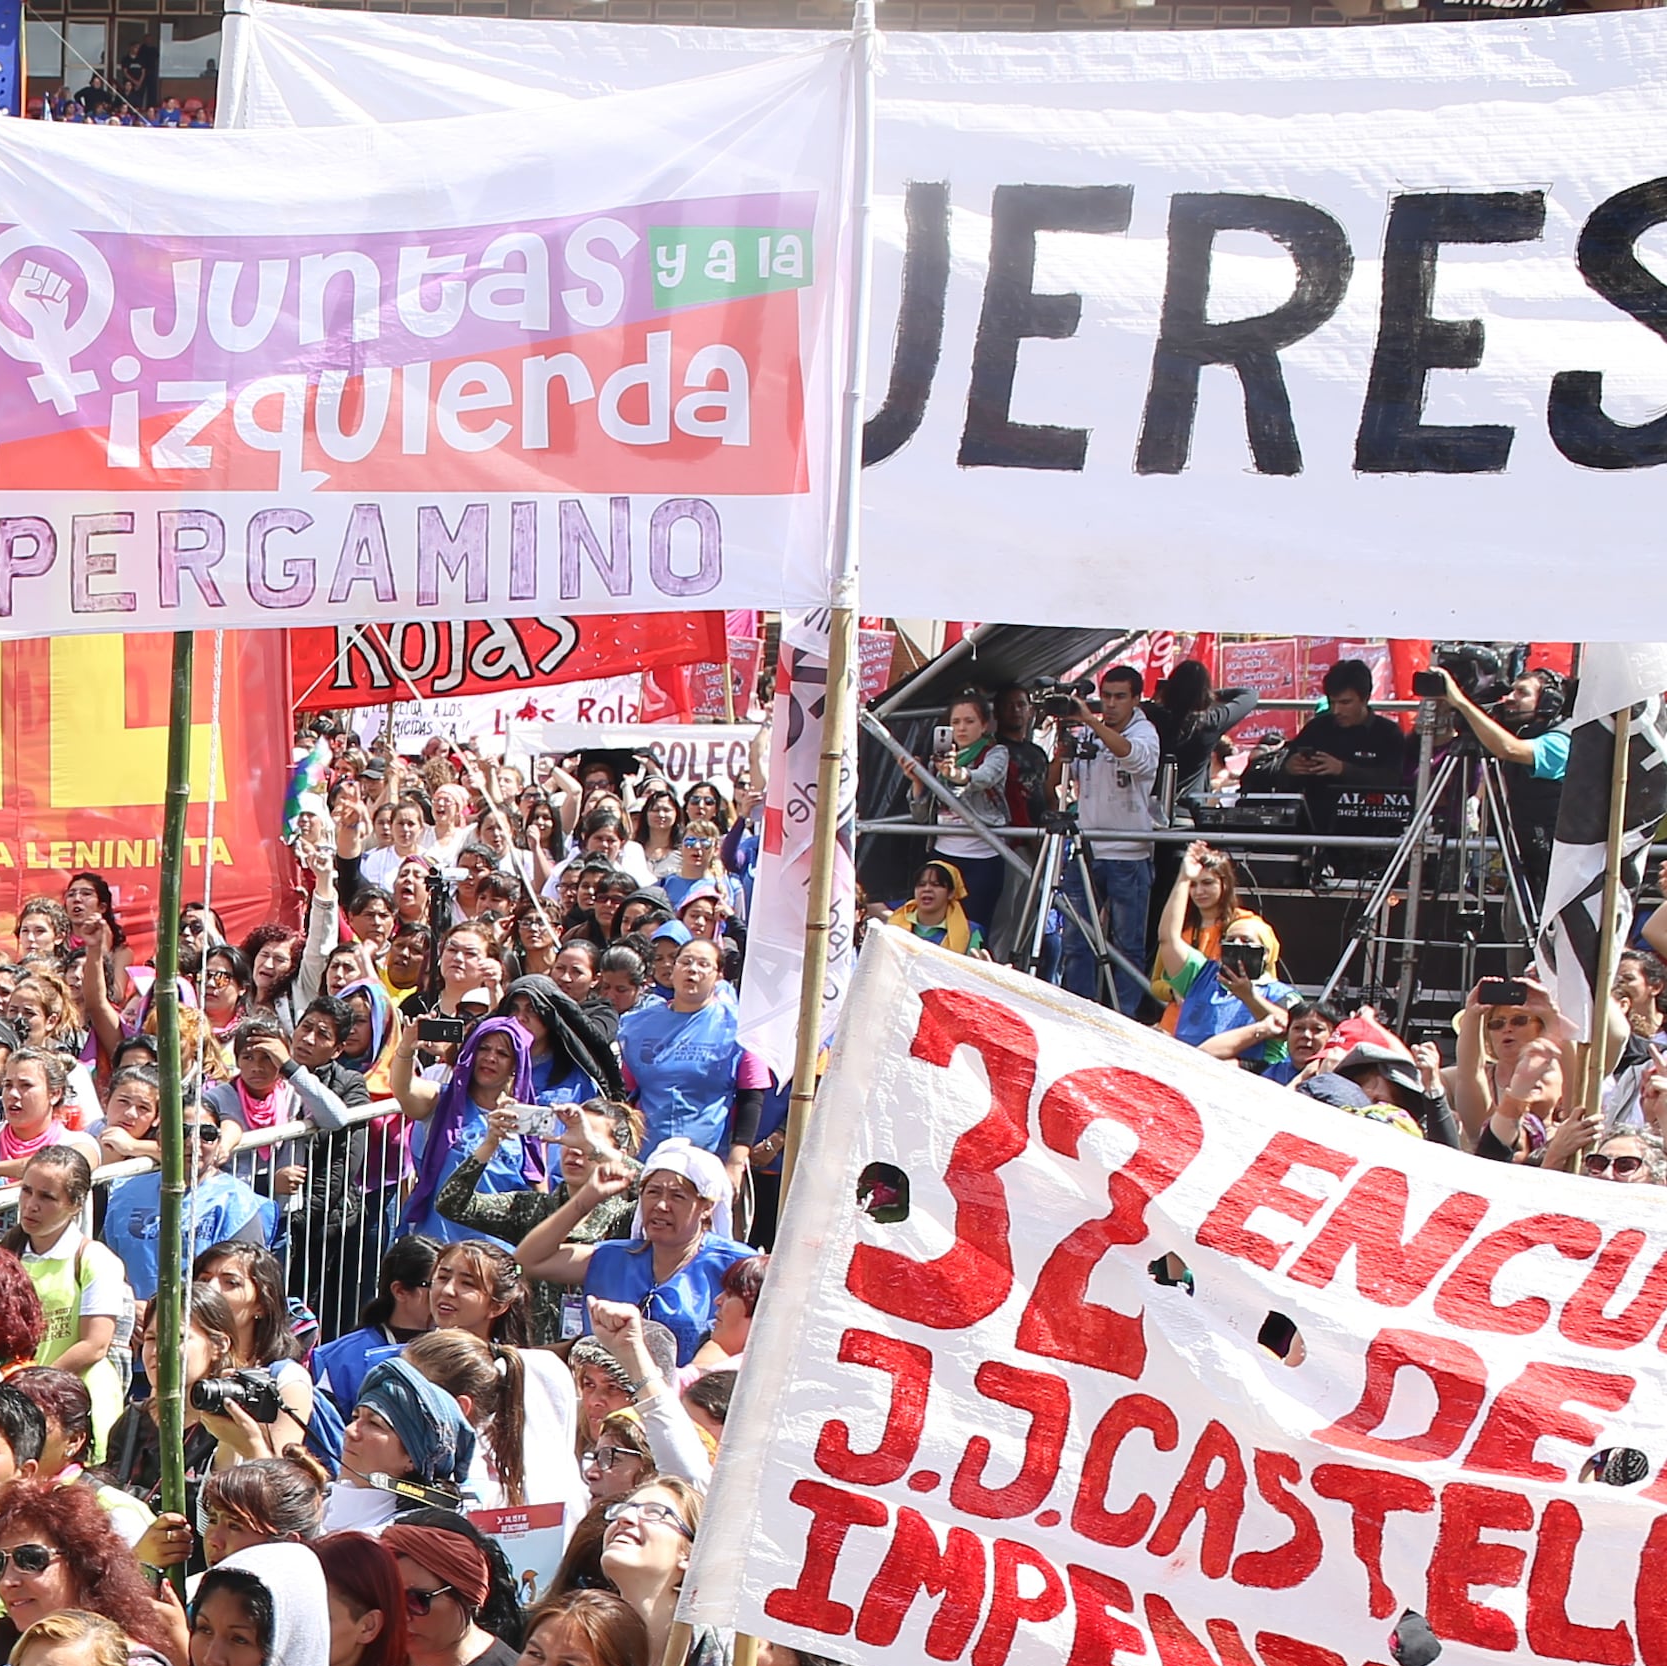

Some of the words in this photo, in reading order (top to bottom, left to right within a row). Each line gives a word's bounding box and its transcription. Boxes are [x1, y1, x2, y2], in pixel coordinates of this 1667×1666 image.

[129, 216, 639, 359] juntas
[655, 242, 687, 288] y
[705, 238, 736, 283] a
[758, 232, 804, 280] la
[106, 328, 752, 491] izquierda
[650, 739, 751, 783] COLEC
[25, 836, 234, 871] LENINITA
[846, 987, 1207, 1379] 32
[1195, 1131, 1667, 1353] ENCU
[1311, 1327, 1637, 1485] DE
